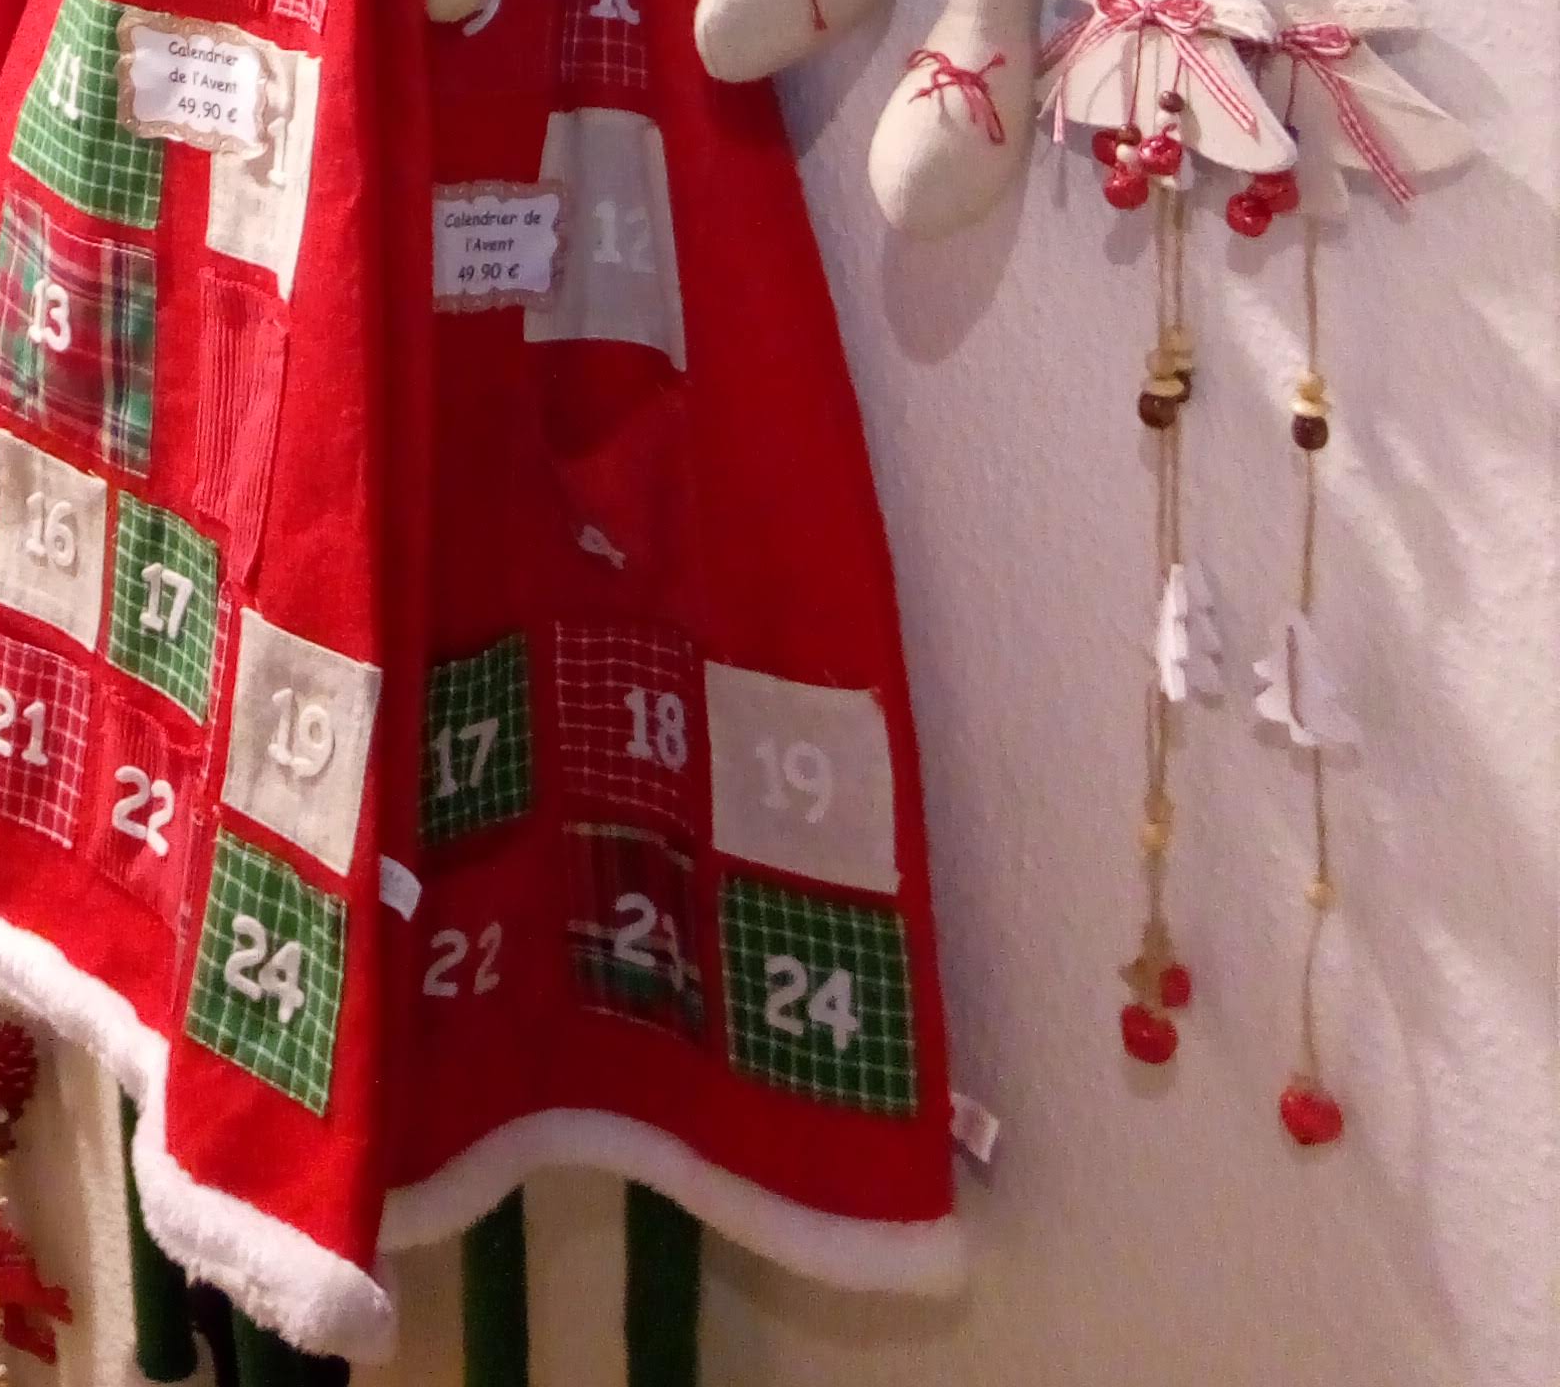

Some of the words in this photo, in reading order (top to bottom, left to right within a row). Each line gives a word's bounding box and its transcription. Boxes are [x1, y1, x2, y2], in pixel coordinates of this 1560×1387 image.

[168, 41, 240, 67] Calendrier
[169, 67, 187, 85] de
[193, 71, 238, 95] l'Avent
[227, 108, 239, 123] €
[444, 212, 518, 228] Calendrier
[524, 210, 541, 226] de
[508, 263, 521, 279] €
[27, 277, 72, 353] 13
[25, 490, 80, 569] 16
[140, 563, 195, 640] 17
[269, 687, 336, 778] 19
[436, 717, 499, 798] 17
[624, 686, 687, 772] 18
[111, 764, 176, 857] 22
[754, 736, 832, 824] 19
[225, 914, 305, 1024] 24
[422, 920, 503, 997] 22
[763, 954, 860, 1051] 24
